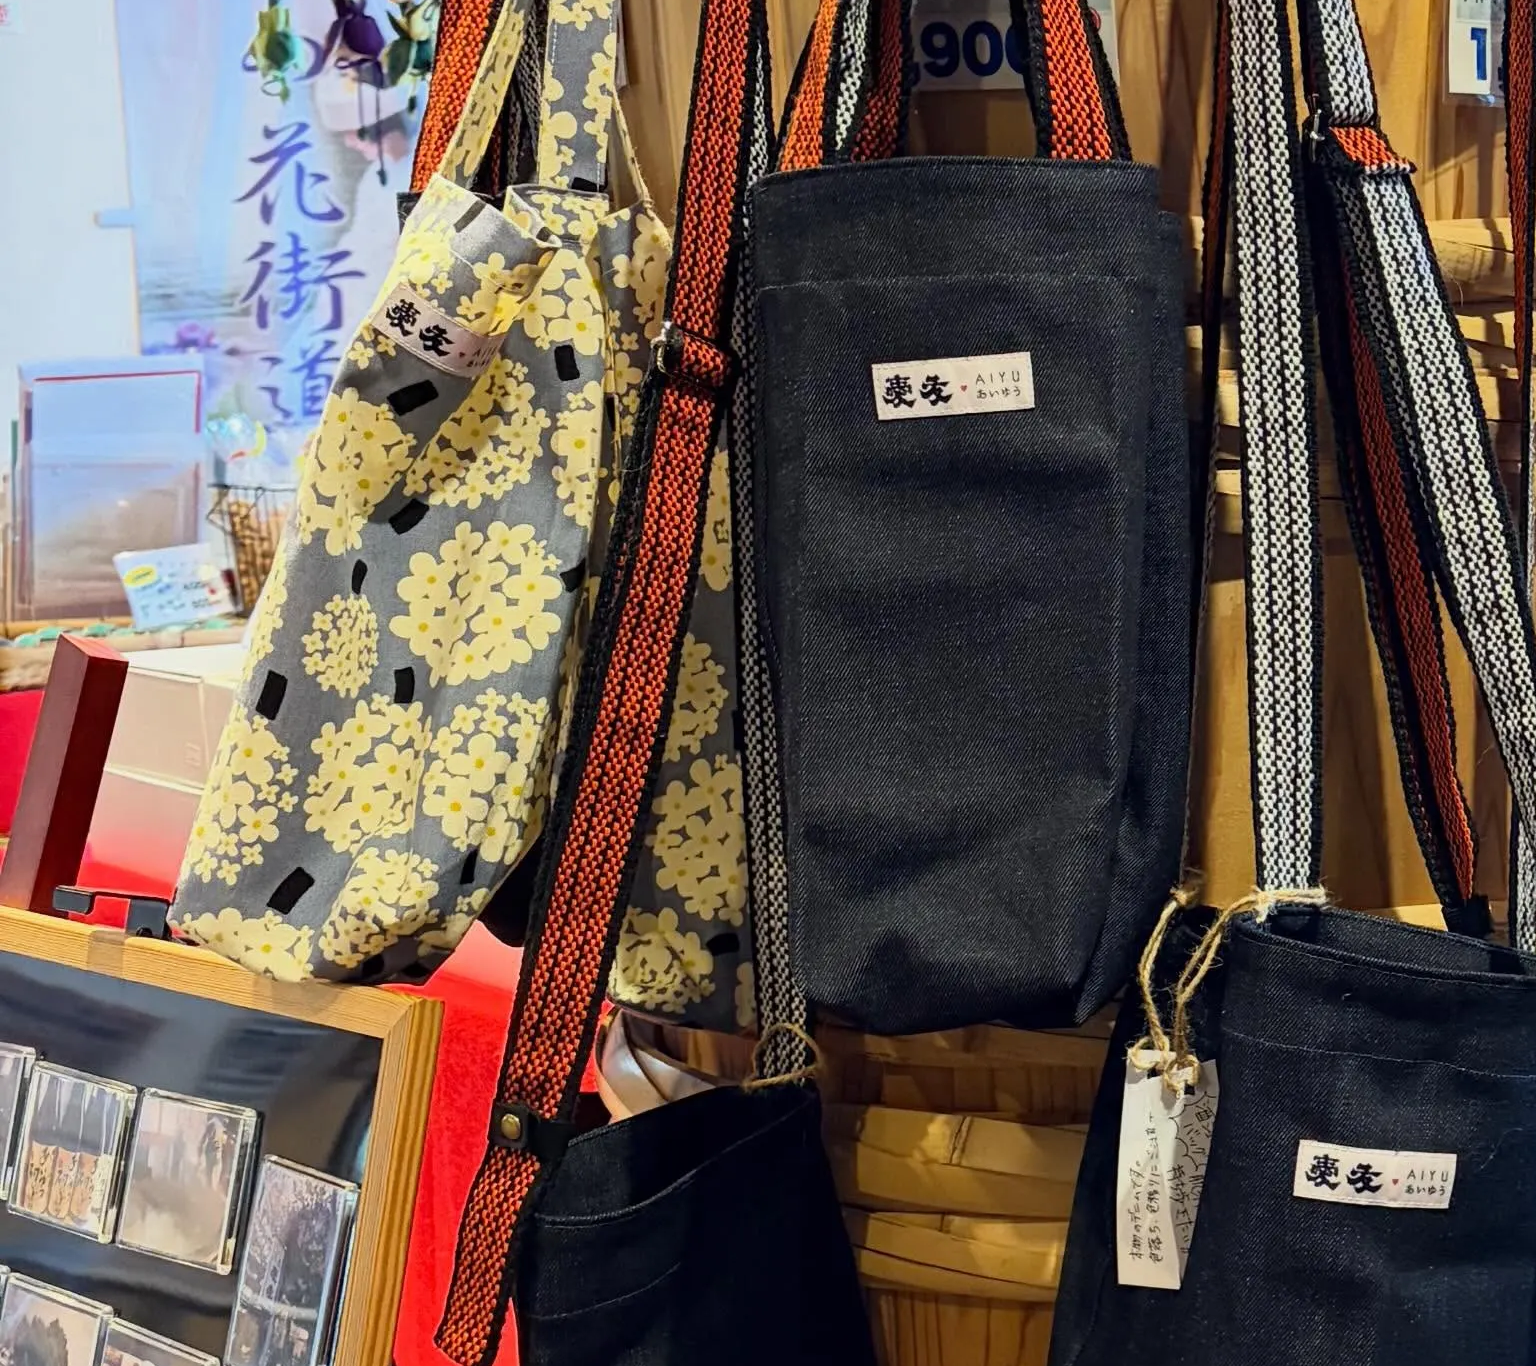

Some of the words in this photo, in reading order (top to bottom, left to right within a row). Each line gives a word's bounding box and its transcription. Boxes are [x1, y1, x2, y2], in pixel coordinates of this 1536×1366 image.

[975, 370, 1021, 385] AIYU
[976, 386, 1022, 400] あいゆう
[1405, 1167, 1450, 1183] AIYU
[1404, 1183, 1447, 1197] あいゆう
